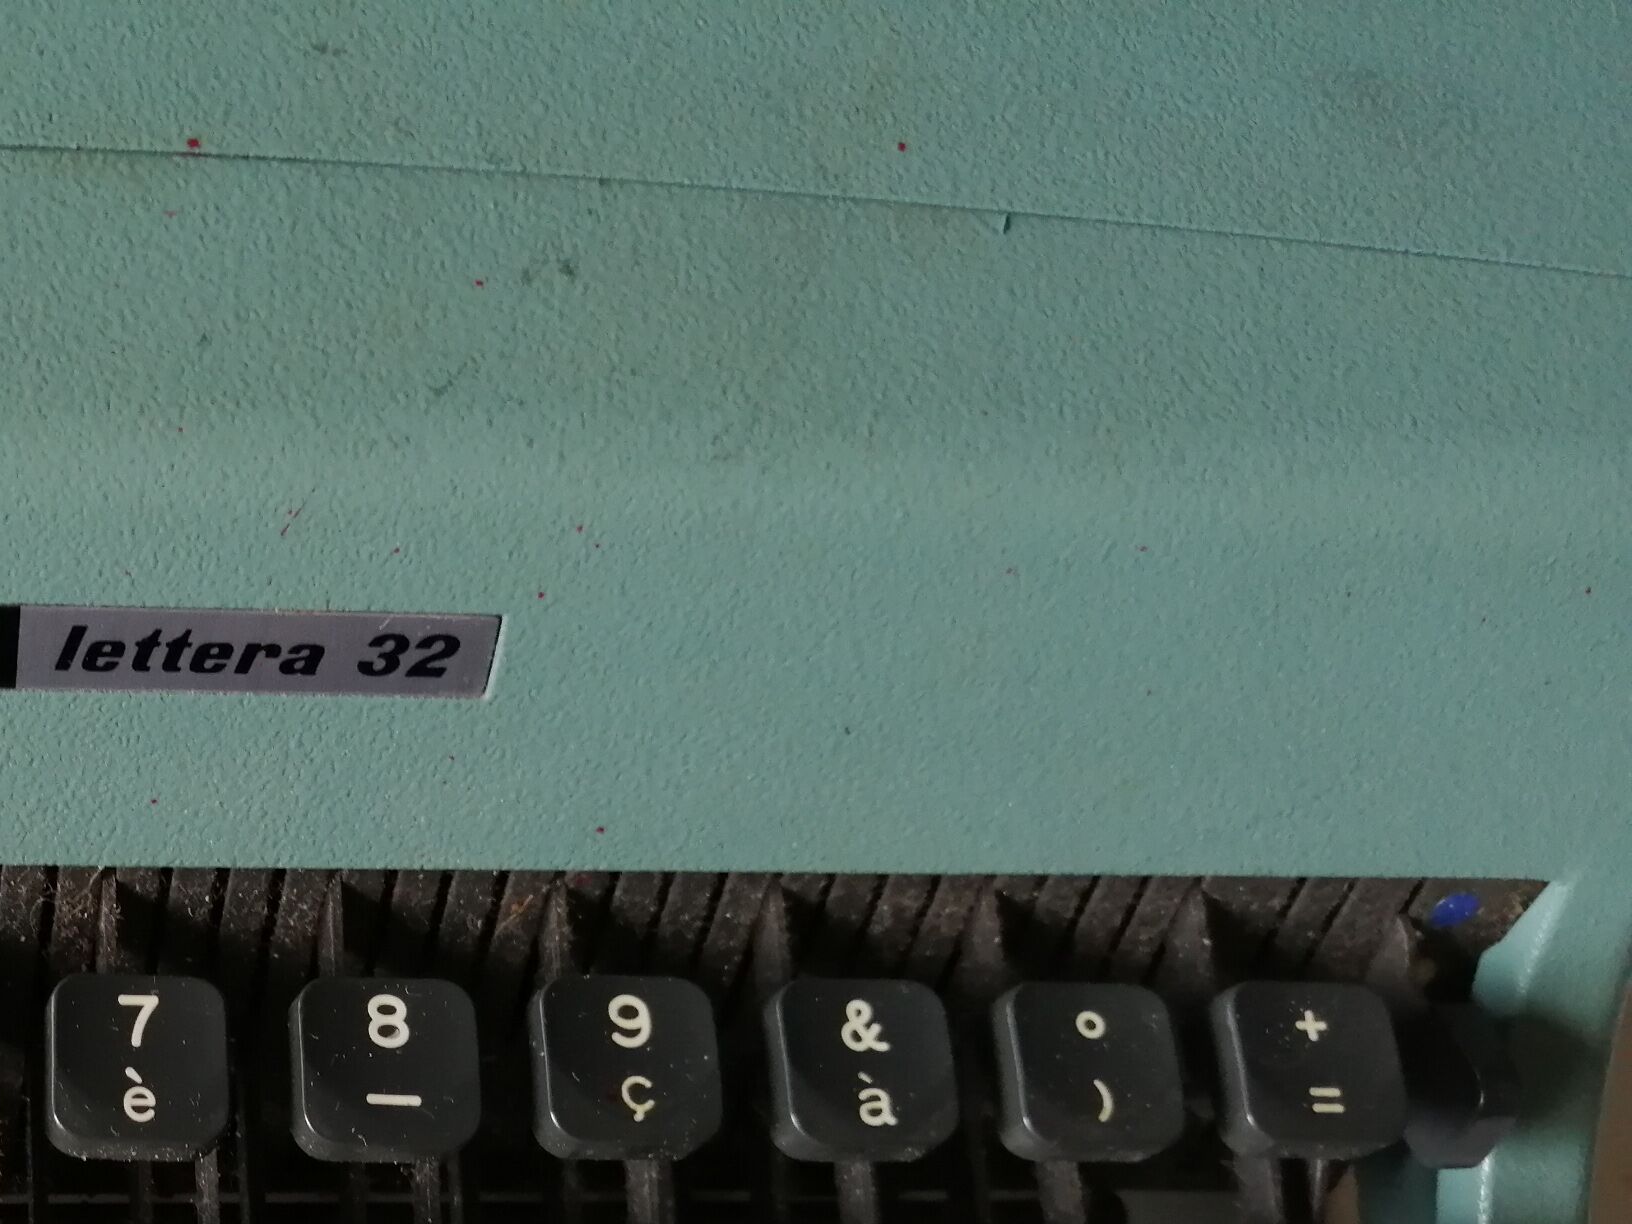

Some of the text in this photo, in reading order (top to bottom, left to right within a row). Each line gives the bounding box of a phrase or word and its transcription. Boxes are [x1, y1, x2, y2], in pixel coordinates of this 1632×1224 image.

[55, 624, 462, 678] lettera 32
[117, 994, 160, 1048] 7
[367, 993, 410, 1049] 8
[607, 994, 652, 1049] 9
[840, 999, 891, 1052] &
[123, 1066, 157, 1123] è
[621, 1075, 655, 1122] ç
[857, 1071, 898, 1127] à
